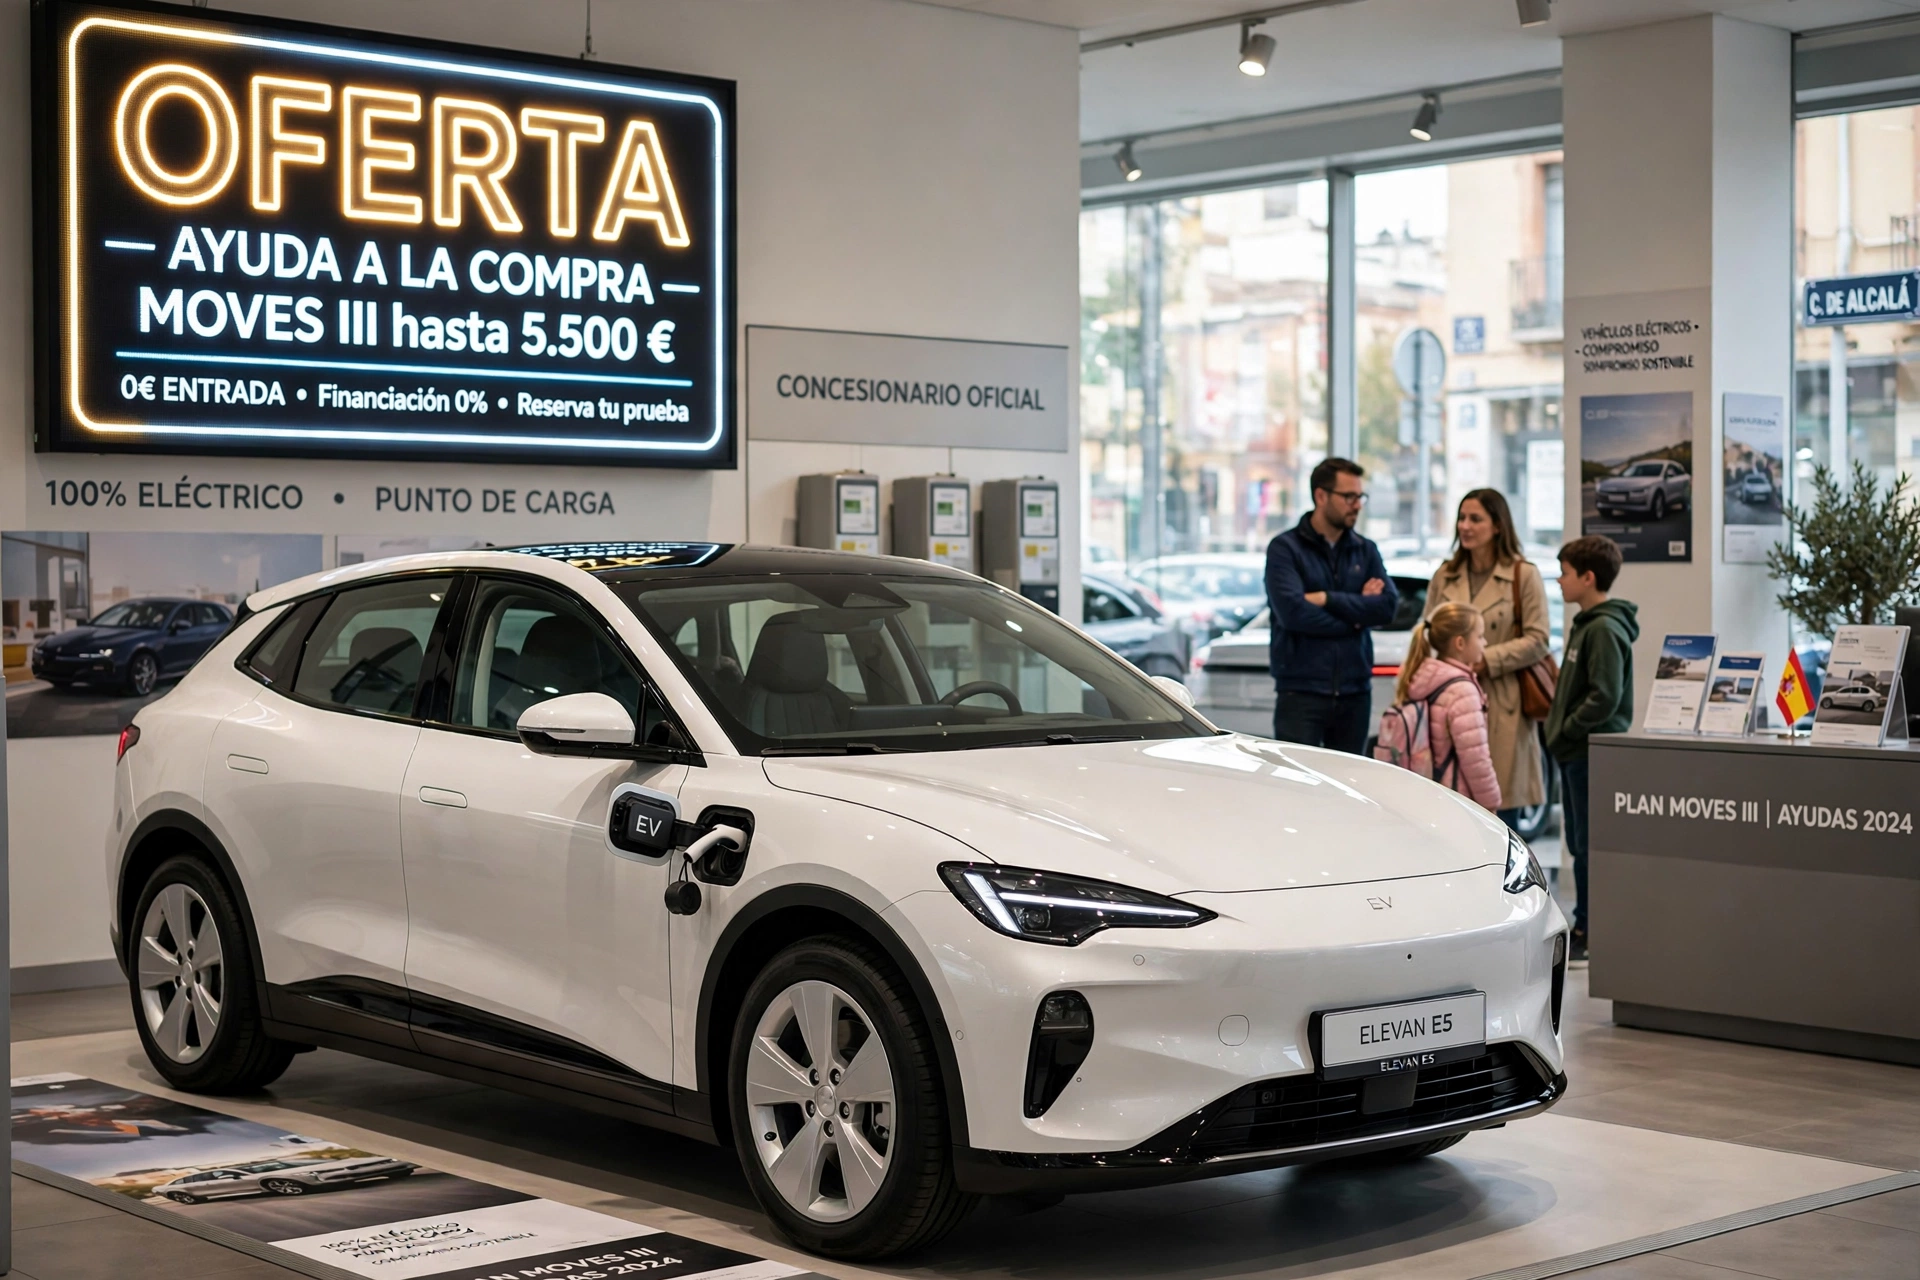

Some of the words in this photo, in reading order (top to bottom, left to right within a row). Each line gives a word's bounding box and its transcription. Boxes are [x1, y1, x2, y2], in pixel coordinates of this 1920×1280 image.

[114, 63, 691, 248] OFERTA
[168, 226, 342, 282] AYUDA
[353, 241, 388, 285] A
[401, 244, 459, 291] LA
[469, 249, 655, 305] COMPRA
[1826, 291, 1845, 315] DE
[1846, 276, 1911, 314] ALCALÁ
[139, 286, 325, 343] MOVES
[339, 300, 377, 346] III
[392, 302, 509, 354] hasta
[521, 311, 638, 361] 5.500
[647, 319, 676, 363] €
[1582, 323, 1634, 339] VEHÍCULOS
[1635, 320, 1692, 336] ELÉCTRICOS
[1582, 340, 1660, 357] COMPROMISO
[120, 374, 156, 400] 0€
[163, 376, 286, 406] ENTRADA
[318, 383, 450, 413] Financiación
[454, 389, 489, 414] 0%
[517, 392, 595, 419] Reserva
[598, 397, 620, 420] tu
[623, 399, 690, 426] prueba
[776, 374, 961, 407] CONCESIONARIO
[967, 385, 1045, 411] OFICIAL
[46, 480, 127, 507] 100%
[138, 475, 303, 510] ELÉCTRICO
[376, 487, 472, 512] PUNTO
[482, 489, 517, 513] DE
[525, 490, 615, 515] CARGA
[636, 814, 662, 837] EV
[1614, 792, 1664, 816] PLAN
[1669, 797, 1737, 822] MOVES
[1742, 801, 1758, 823] III
[1777, 804, 1858, 831] AYUDAS
[1863, 810, 1913, 834] 2024
[1366, 895, 1393, 910] EV
[1360, 1017, 1425, 1045] ELEVAN
[1432, 1013, 1453, 1034] E5
[1380, 1055, 1419, 1072] ELEVAN
[518, 1253, 625, 1277] MOVES
[607, 1256, 683, 1275] 2024
